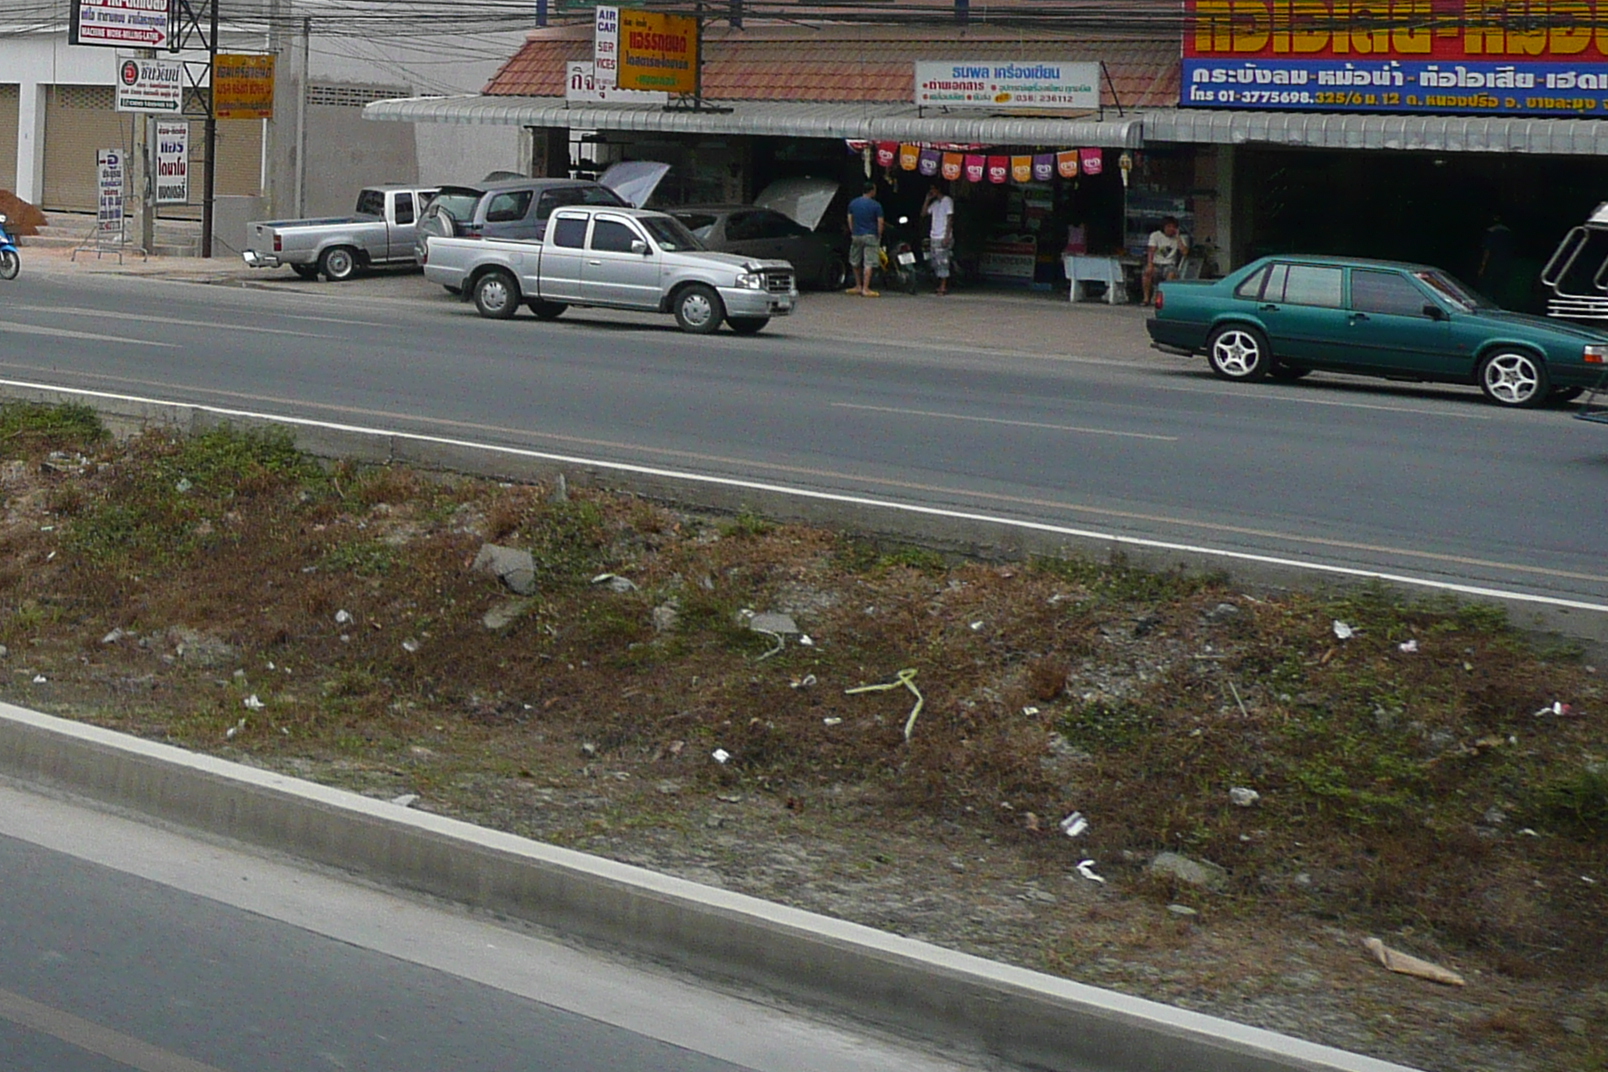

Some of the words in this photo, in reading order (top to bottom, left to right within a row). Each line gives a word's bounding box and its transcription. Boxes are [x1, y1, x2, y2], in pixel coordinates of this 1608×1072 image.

[598, 10, 616, 21] AIR
[597, 22, 616, 33] CAR
[598, 41, 614, 52] SER
[596, 58, 615, 70] VICES
[952, 66, 989, 79] ธนพล
[994, 63, 1060, 79] เครื่องเขียน
[929, 77, 985, 91] ถ่ายเอกสาร
[1190, 85, 1214, 101] โทร
[1382, 93, 1400, 106] 12
[158, 156, 186, 176] ไดนาโม
